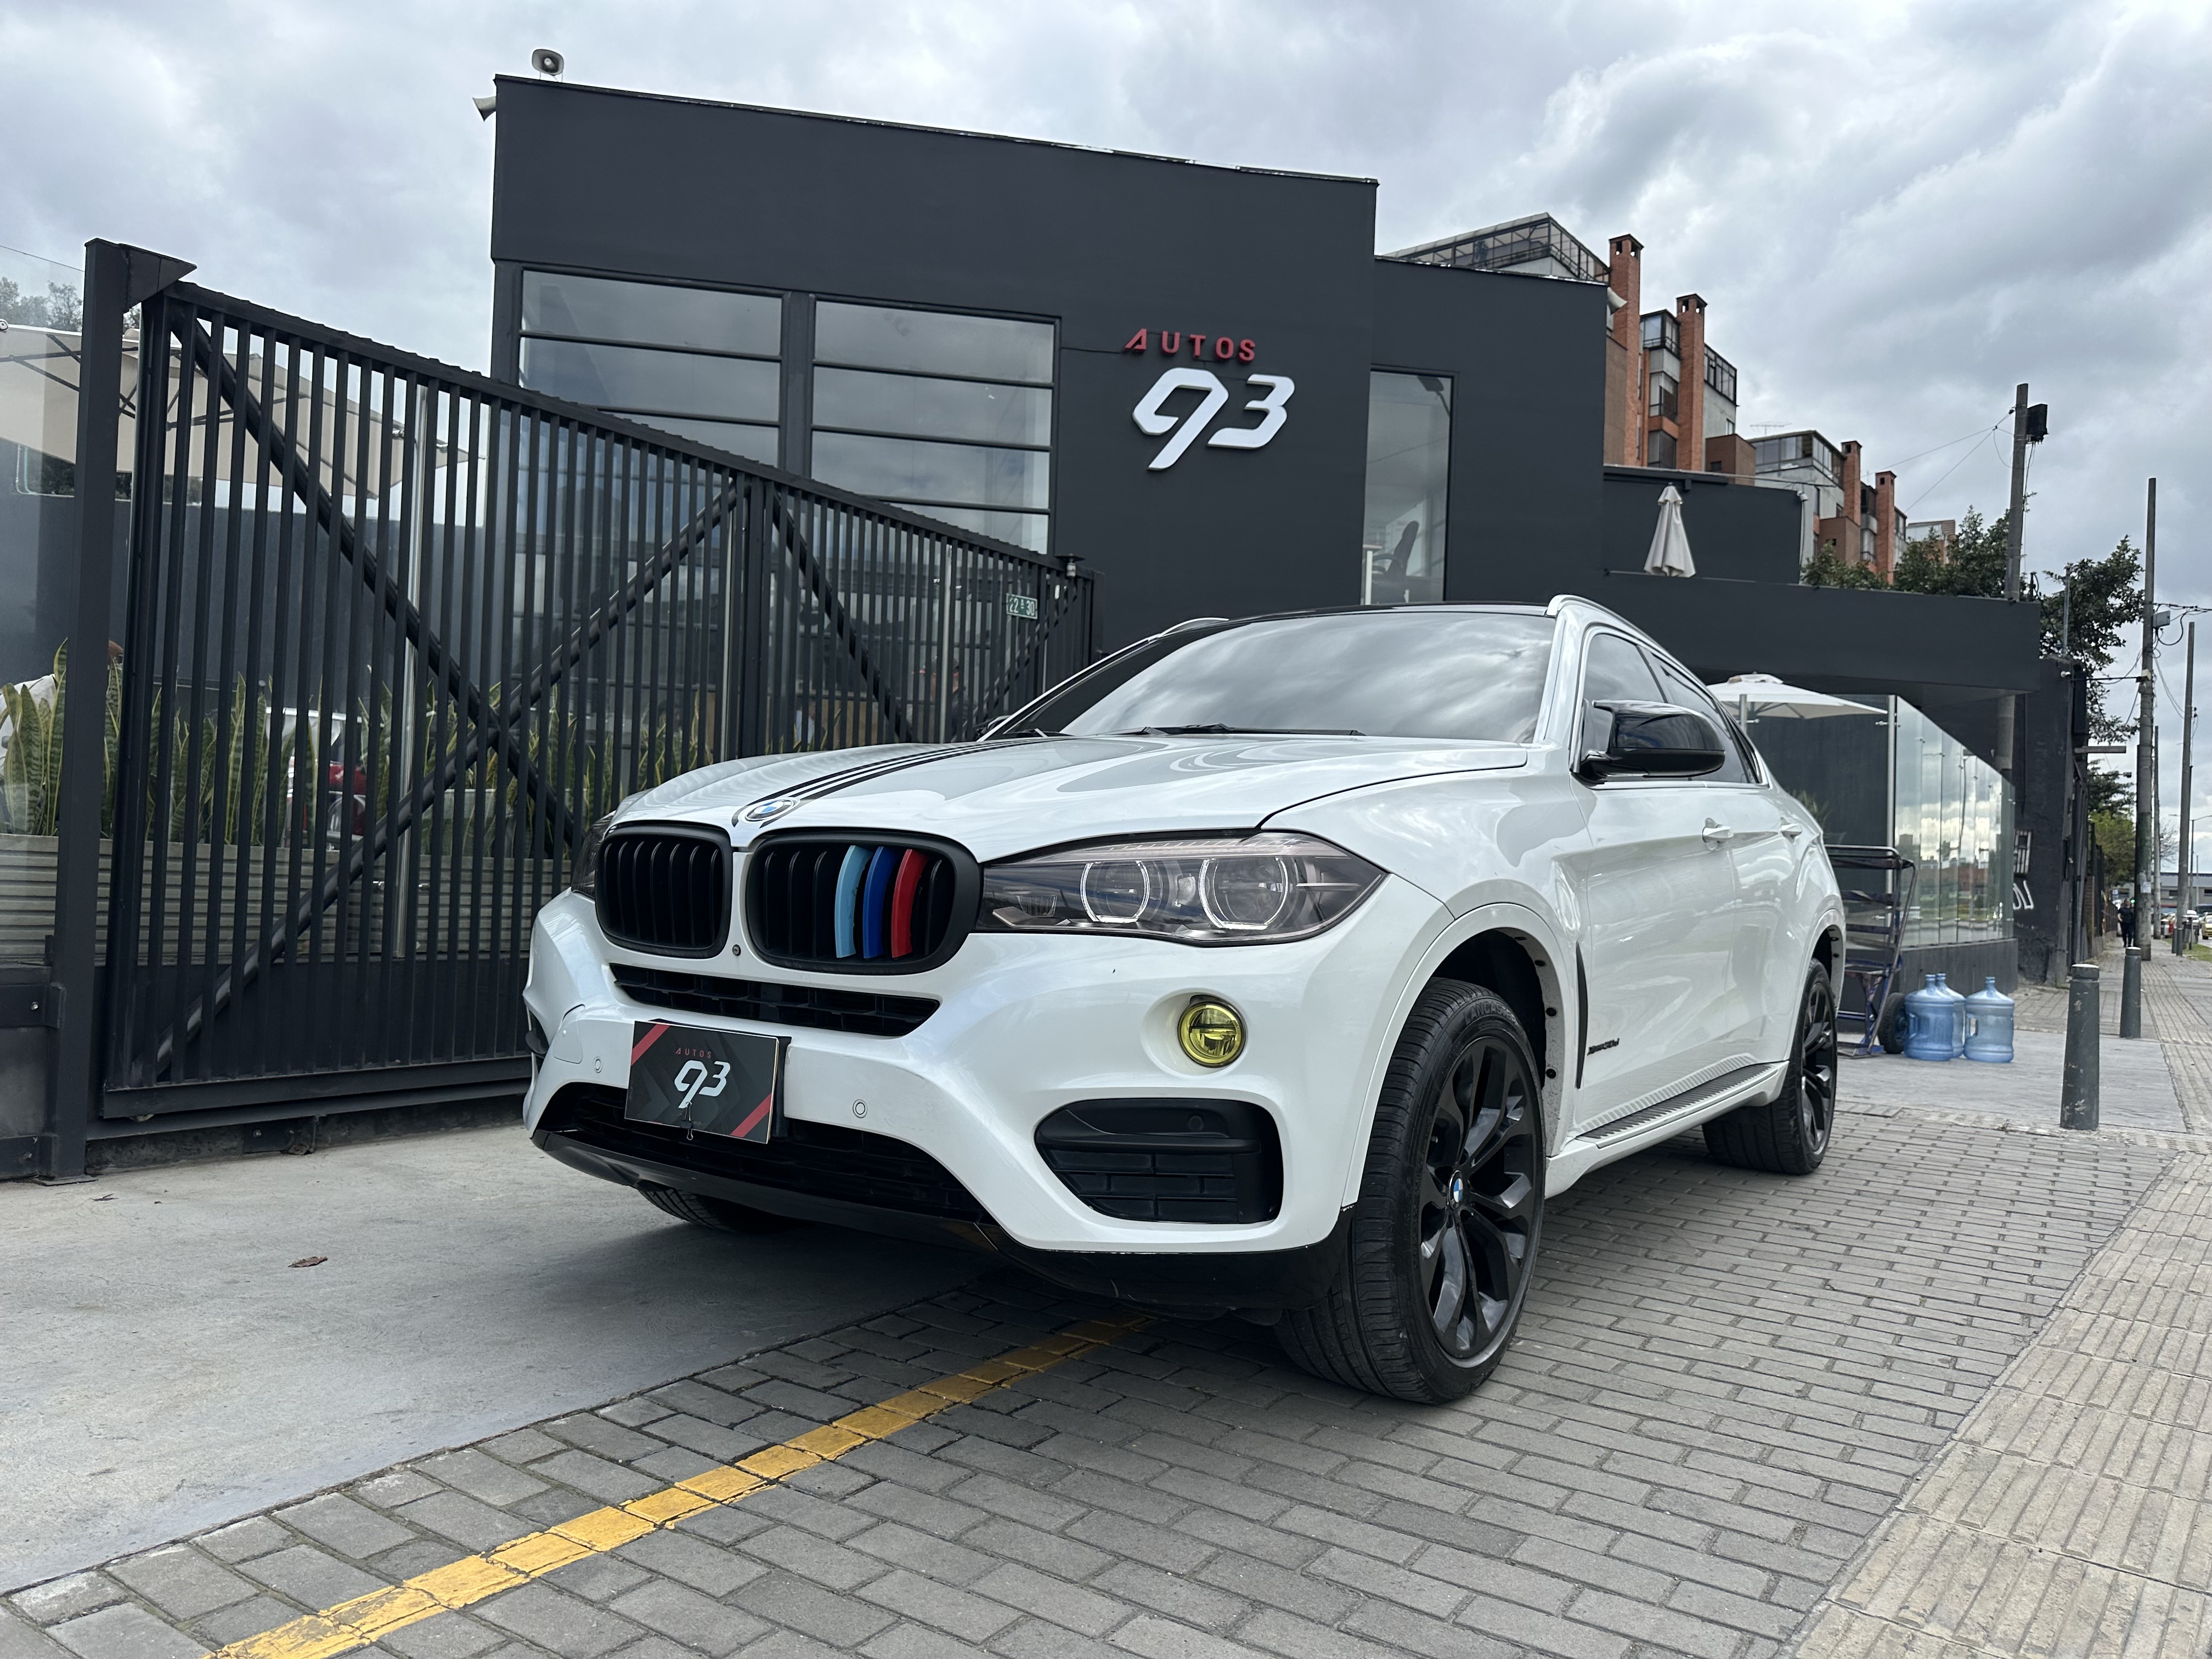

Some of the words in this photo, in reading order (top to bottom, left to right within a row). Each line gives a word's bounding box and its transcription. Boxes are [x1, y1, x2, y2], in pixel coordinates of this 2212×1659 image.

[1124, 328, 1256, 362] AUTOS
[1132, 367, 1295, 471] 93
[1463, 1000, 1520, 1026] LANCASTER
[675, 1047, 712, 1059] AUTOS
[674, 1059, 731, 1109] 93
